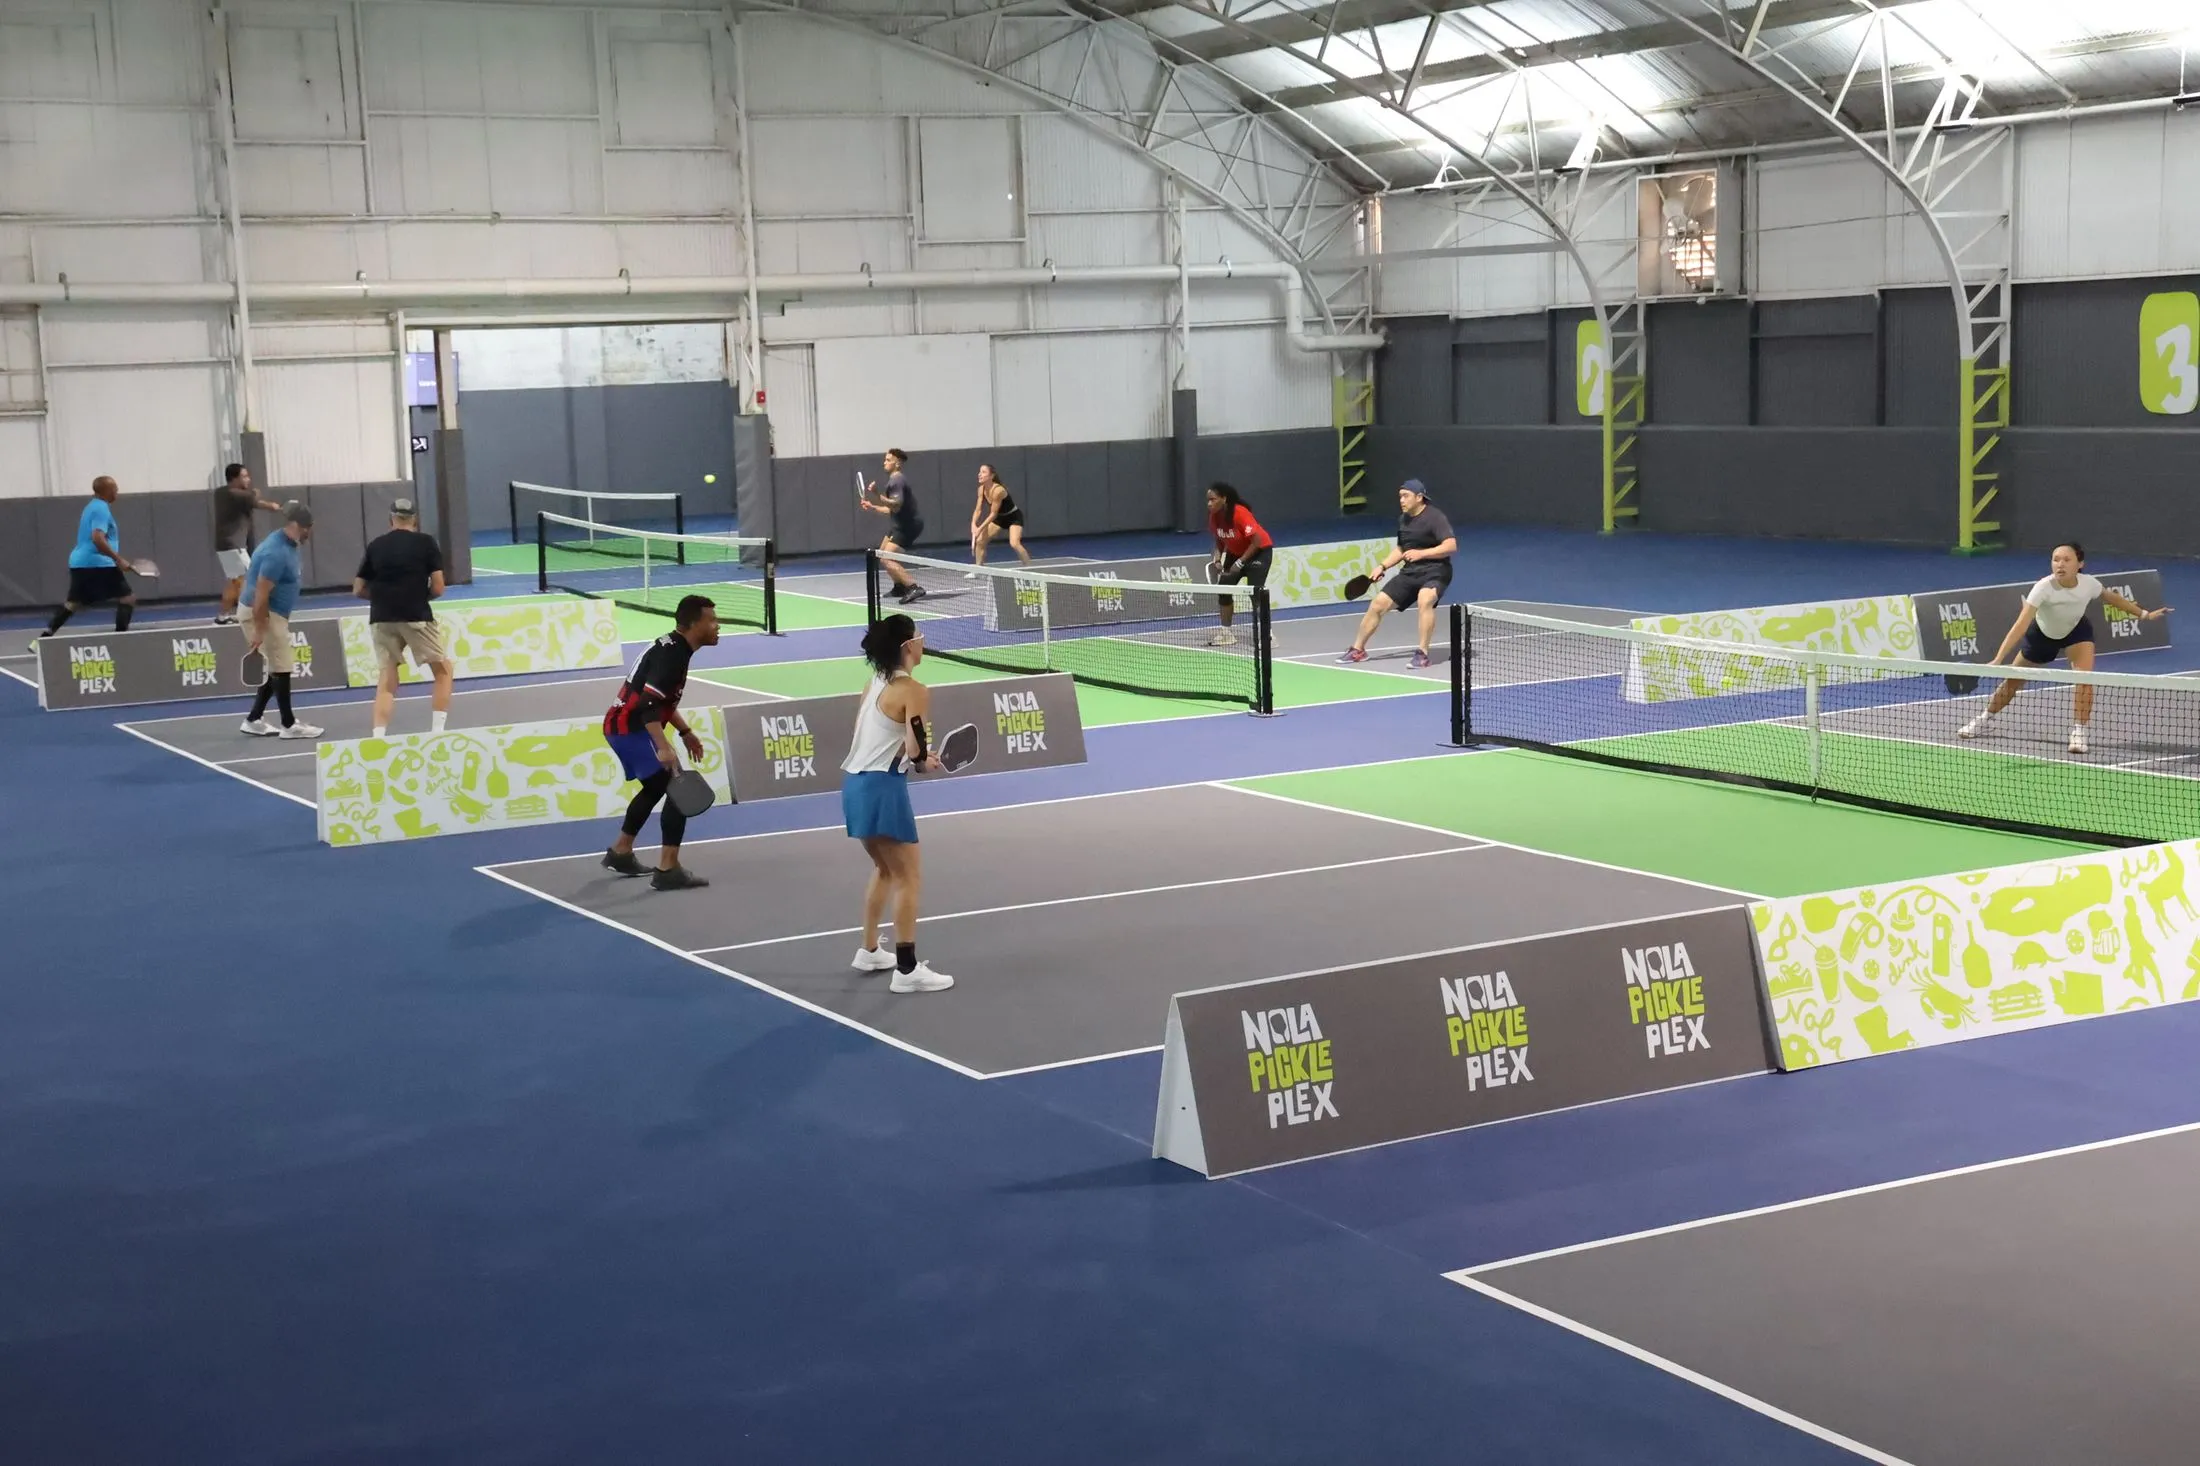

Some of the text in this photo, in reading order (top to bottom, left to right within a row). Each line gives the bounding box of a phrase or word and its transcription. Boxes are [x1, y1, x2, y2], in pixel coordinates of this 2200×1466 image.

[2155, 323, 2198, 414] 3
[1160, 566, 1190, 582] NOLA
[1022, 603, 1043, 618] PLE
[1938, 601, 1973, 623] NOLA
[1941, 618, 1977, 640] PICKLE
[2111, 618, 2142, 639] PLEX
[69, 645, 111, 665] NOLA
[172, 637, 212, 657] NOLA
[1949, 637, 1980, 657] PLEX
[71, 659, 115, 680] PICKLE
[174, 652, 217, 672] PICKLE
[79, 675, 117, 695] PLEX
[182, 668, 218, 687] PLEX
[993, 690, 1040, 714] NOLA
[760, 714, 810, 738] NOLA
[995, 709, 1045, 736] PICKLE
[763, 732, 815, 761] PICKLE
[1006, 732, 1048, 754] PLEX
[774, 756, 817, 780] PLEX
[1621, 941, 1695, 991] NOLA
[1440, 970, 1518, 1021] NOLA
[1627, 976, 1705, 1025] PICKLE
[1241, 1003, 1323, 1056] NOLA
[1447, 1006, 1529, 1057] PICKLE
[1646, 1015, 1711, 1059] PLEX
[1248, 1039, 1334, 1093] PICKLE
[1466, 1046, 1535, 1092] PLEX
[1268, 1081, 1340, 1129] PLEX
